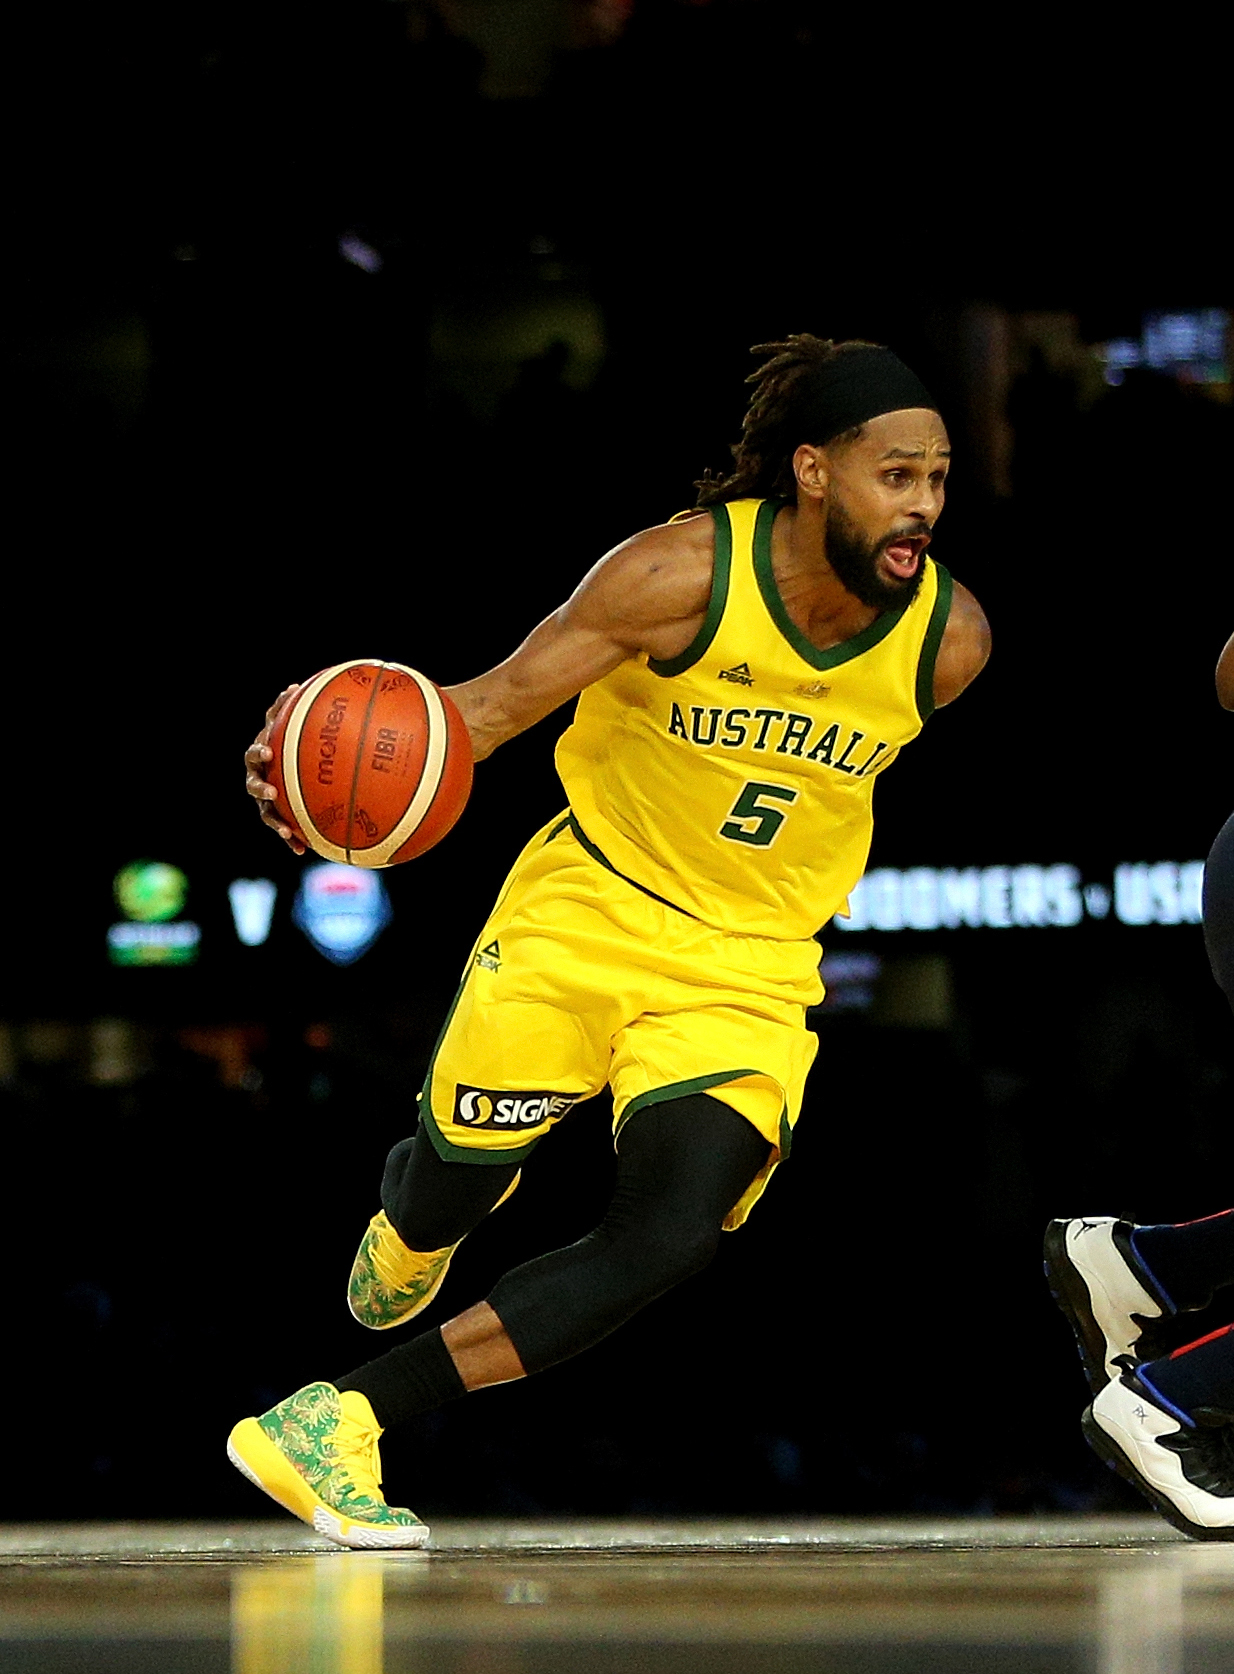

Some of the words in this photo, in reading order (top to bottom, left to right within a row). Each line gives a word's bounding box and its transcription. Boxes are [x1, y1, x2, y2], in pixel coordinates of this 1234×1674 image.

[717, 669, 756, 687] PEAK
[317, 696, 349, 786] molten
[371, 727, 398, 774] FIBA
[667, 701, 899, 778] AUSTRALI
[719, 779, 798, 849] 5
[493, 1096, 574, 1124] SIGNE
